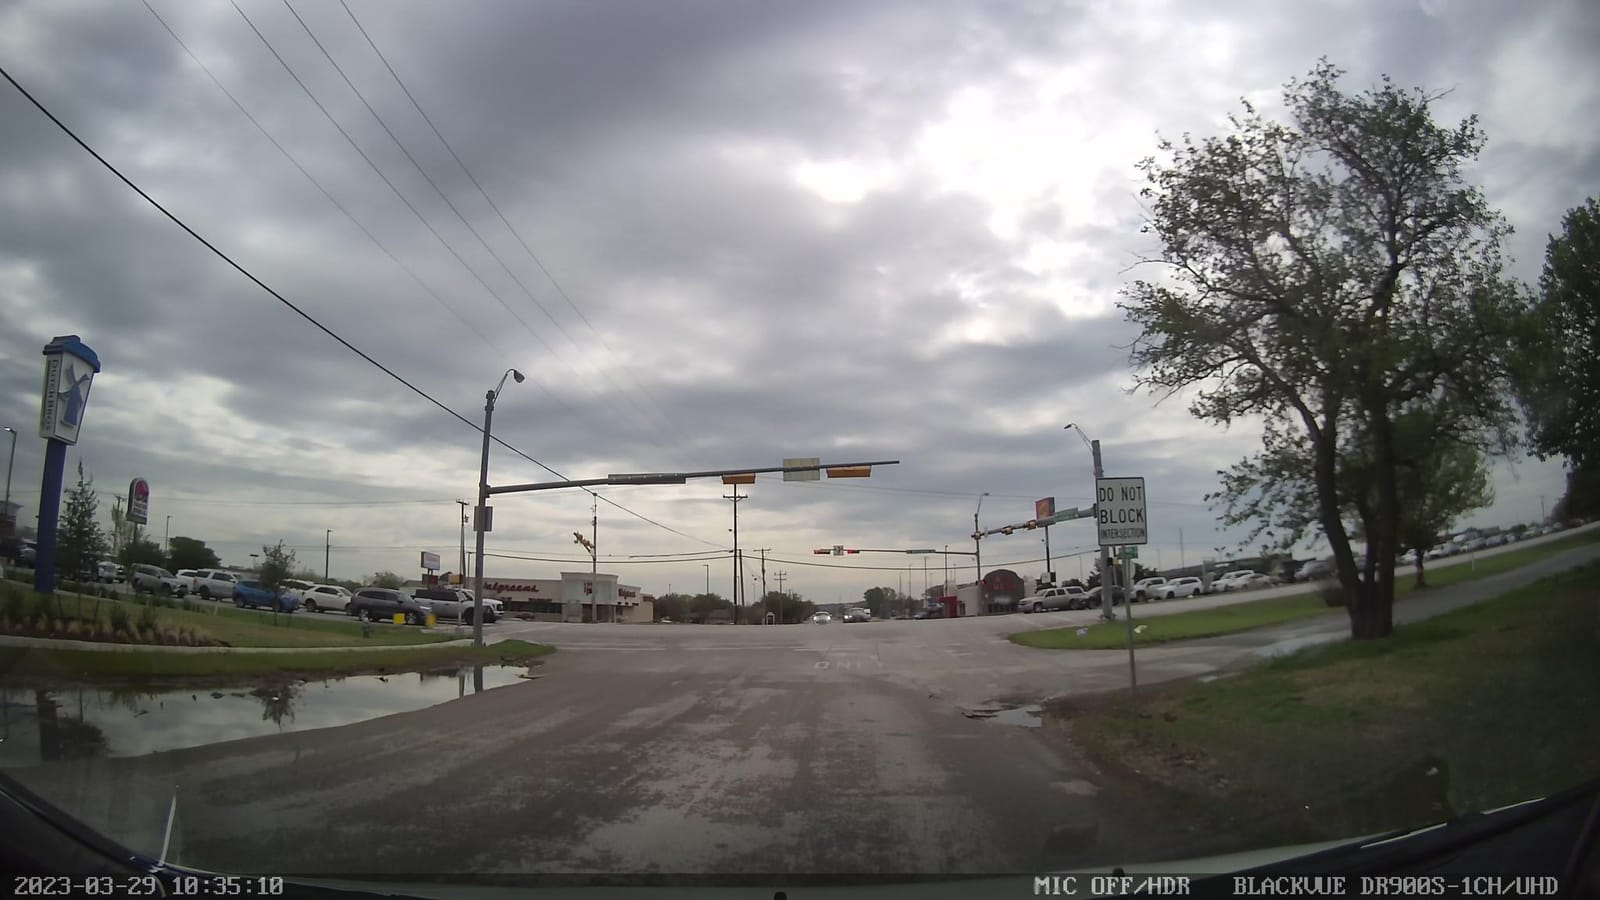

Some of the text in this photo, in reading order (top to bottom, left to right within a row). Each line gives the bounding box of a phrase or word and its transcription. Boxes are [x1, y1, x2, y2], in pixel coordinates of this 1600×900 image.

[1099, 486, 1142, 502] DO NOT
[1100, 508, 1144, 524] BLOCK
[1101, 527, 1145, 539] INTERSECTION
